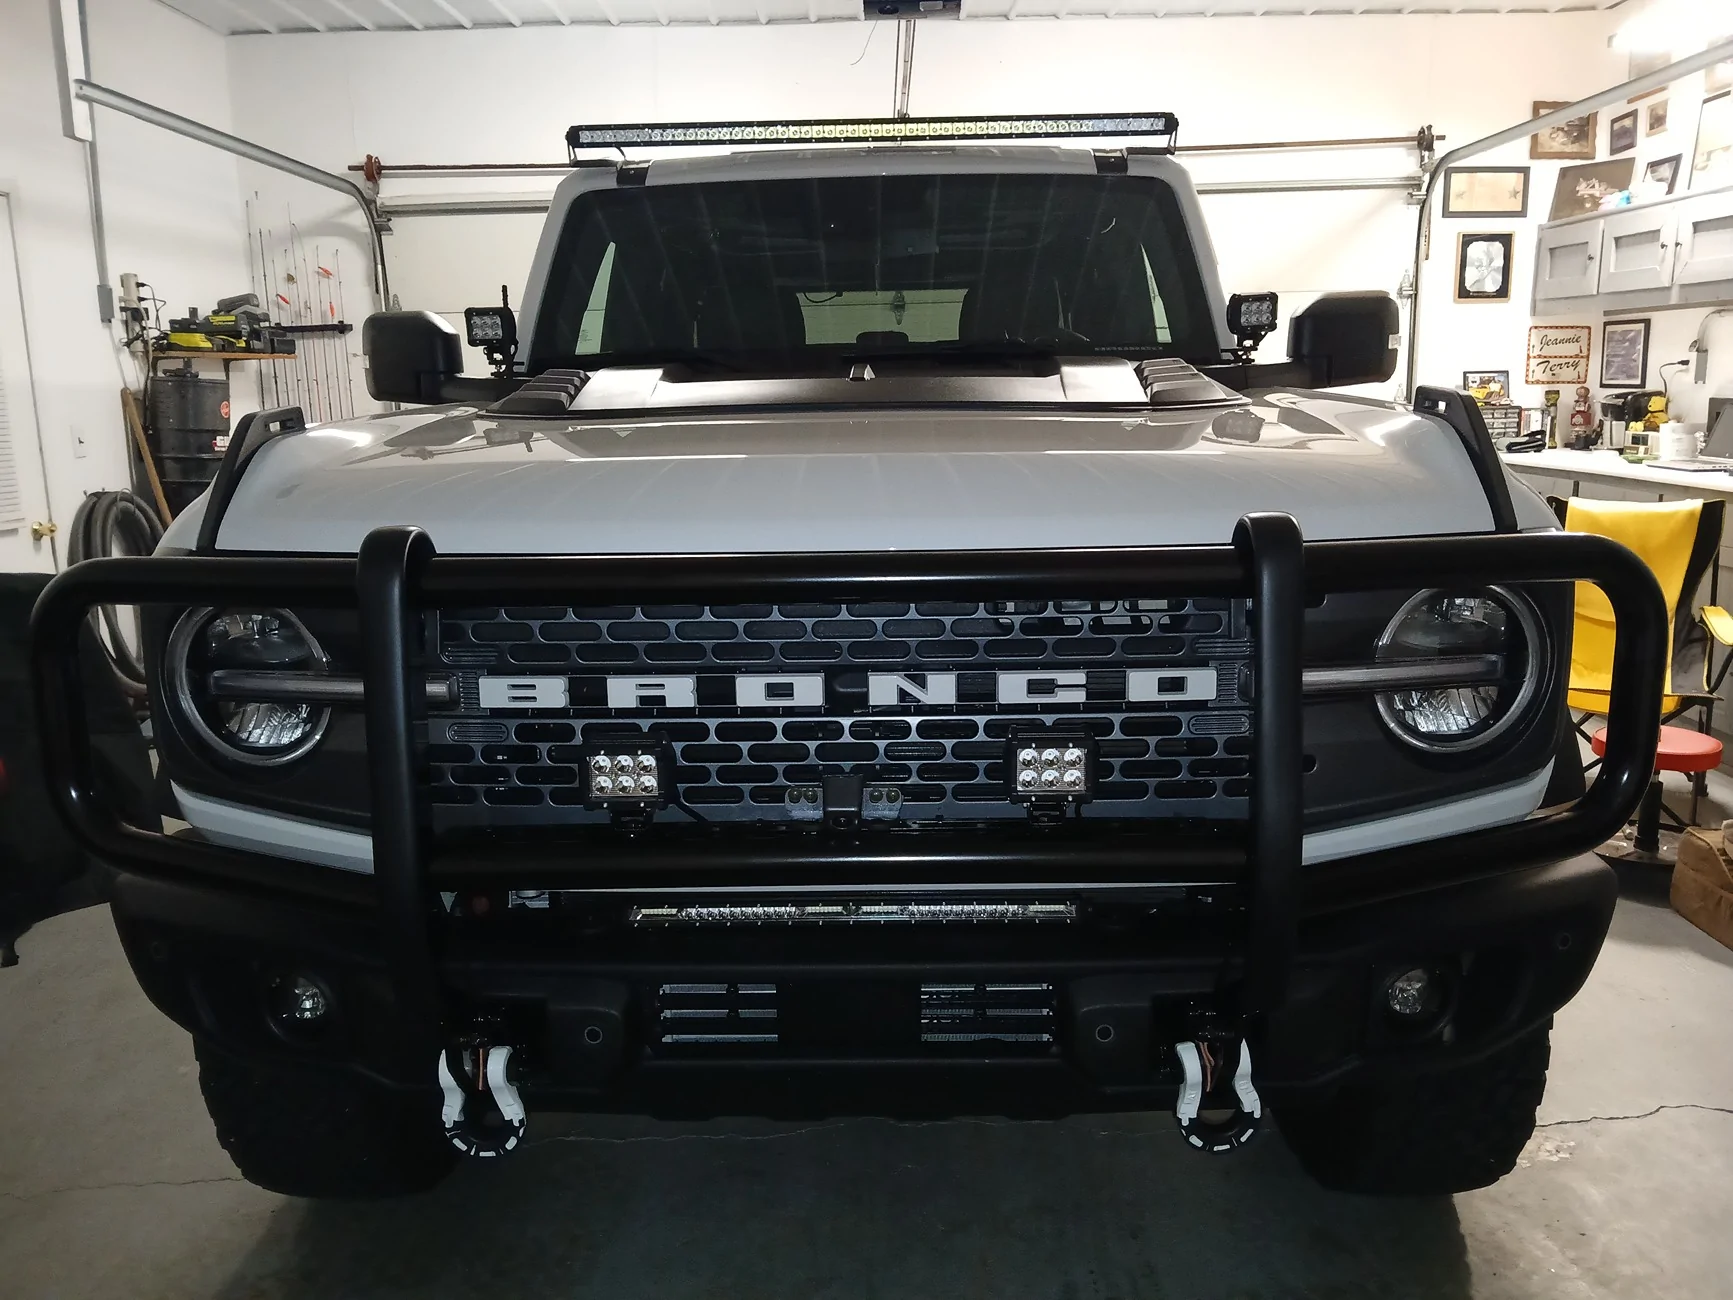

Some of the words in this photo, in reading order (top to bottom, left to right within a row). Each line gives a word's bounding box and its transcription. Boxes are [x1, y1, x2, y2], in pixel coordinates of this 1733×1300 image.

[1539, 334, 1582, 352] Jeannie
[1536, 359, 1581, 374] Terry
[478, 667, 1218, 709] BRONCO
